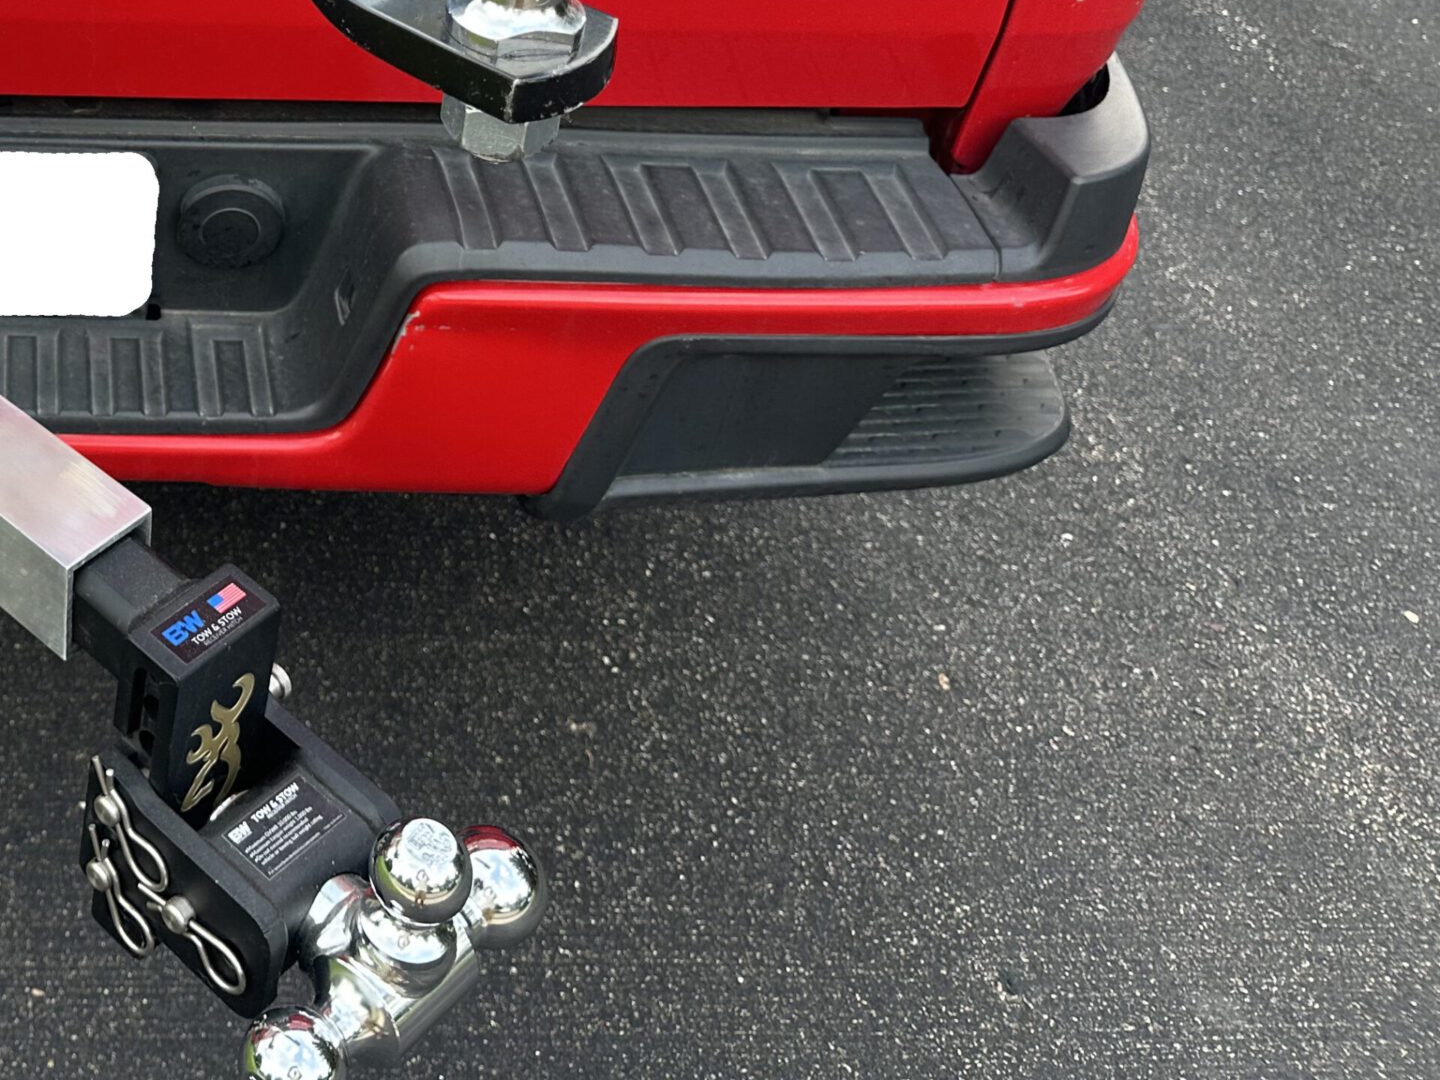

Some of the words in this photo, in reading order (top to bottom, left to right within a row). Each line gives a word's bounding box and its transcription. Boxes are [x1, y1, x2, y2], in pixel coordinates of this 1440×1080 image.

[190, 627, 212, 645] TOW
[211, 623, 219, 632] &
[217, 606, 242, 627] STOW
[250, 803, 271, 823] TOW
[269, 799, 279, 809] &
[275, 781, 300, 803] STOW
